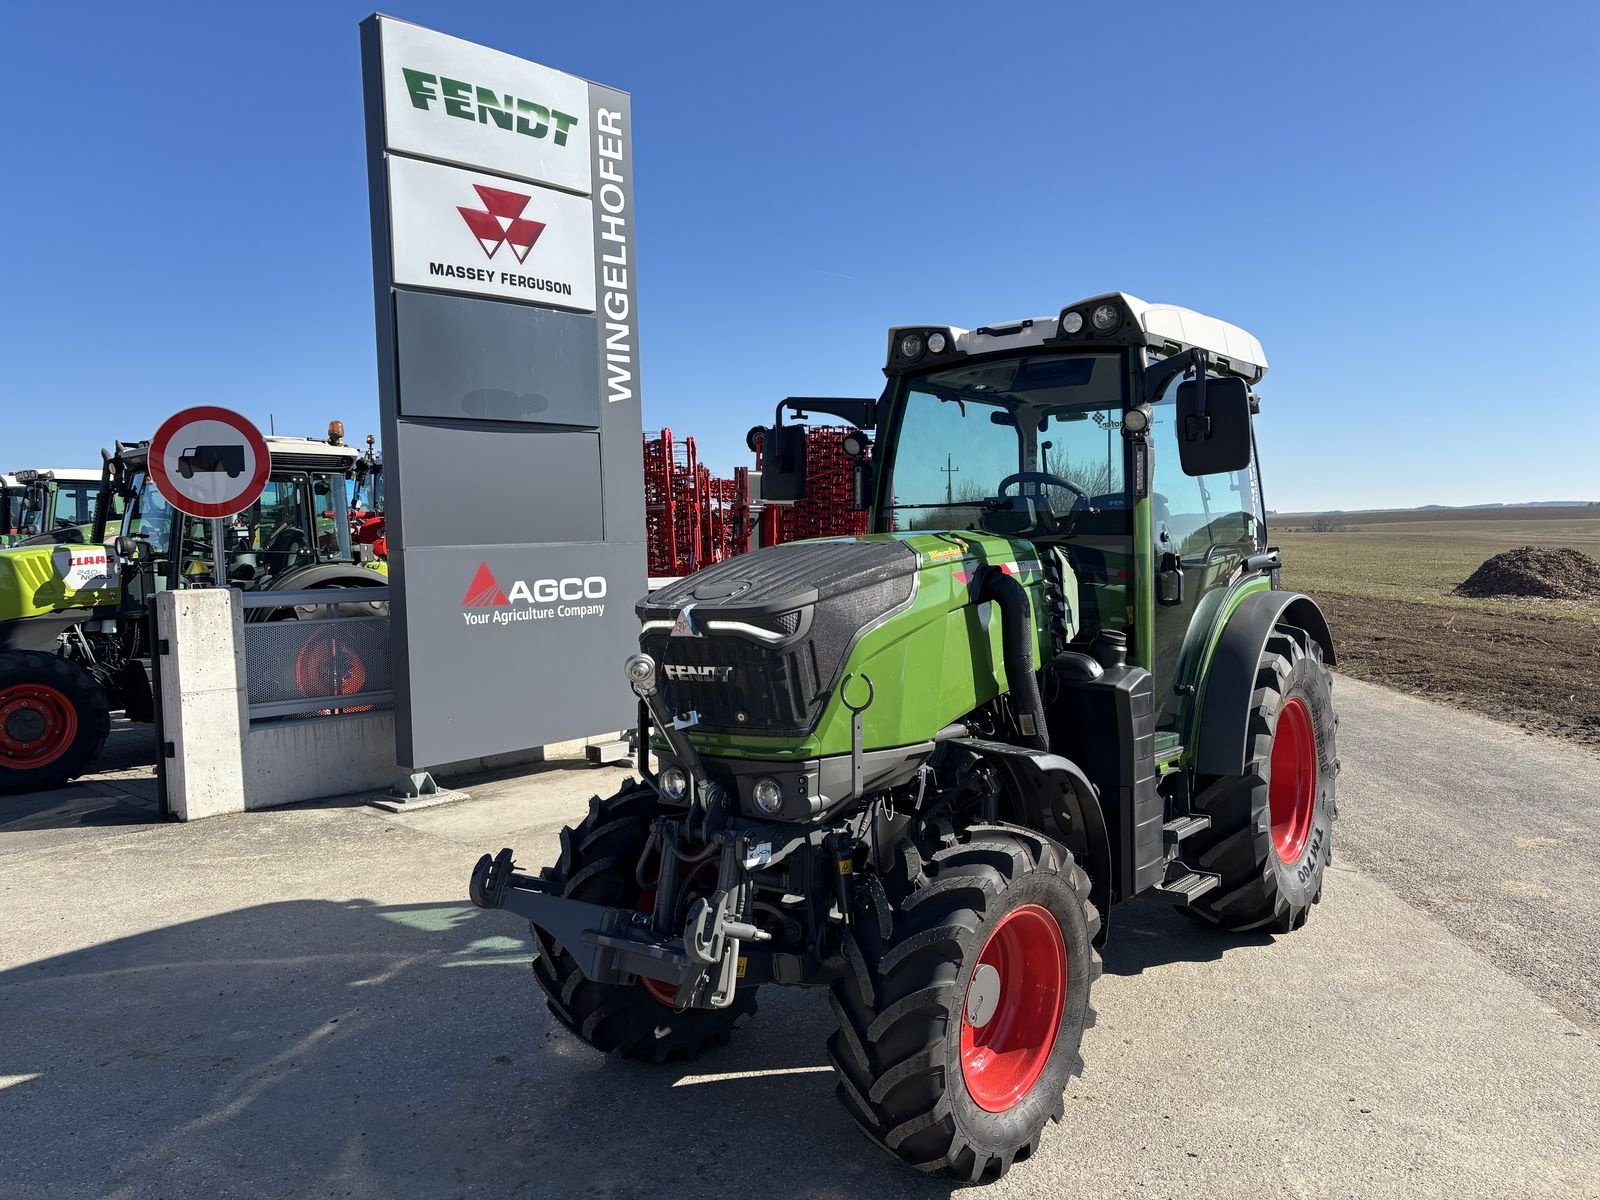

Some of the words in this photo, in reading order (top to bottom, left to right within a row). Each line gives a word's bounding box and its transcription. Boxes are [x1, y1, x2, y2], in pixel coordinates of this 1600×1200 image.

[402, 67, 578, 147] FENDT
[597, 107, 632, 403] WINGELHOFER
[429, 262, 495, 283] MASSEY
[500, 272, 572, 296] FERGUSON
[68, 555, 114, 567] CLAAS
[508, 576, 607, 605] AGCO
[463, 612, 490, 625] Your
[493, 607, 555, 626] Agriculture
[557, 604, 605, 619] Company
[663, 664, 733, 683] FENDT
[1297, 827, 1324, 884] TM700
